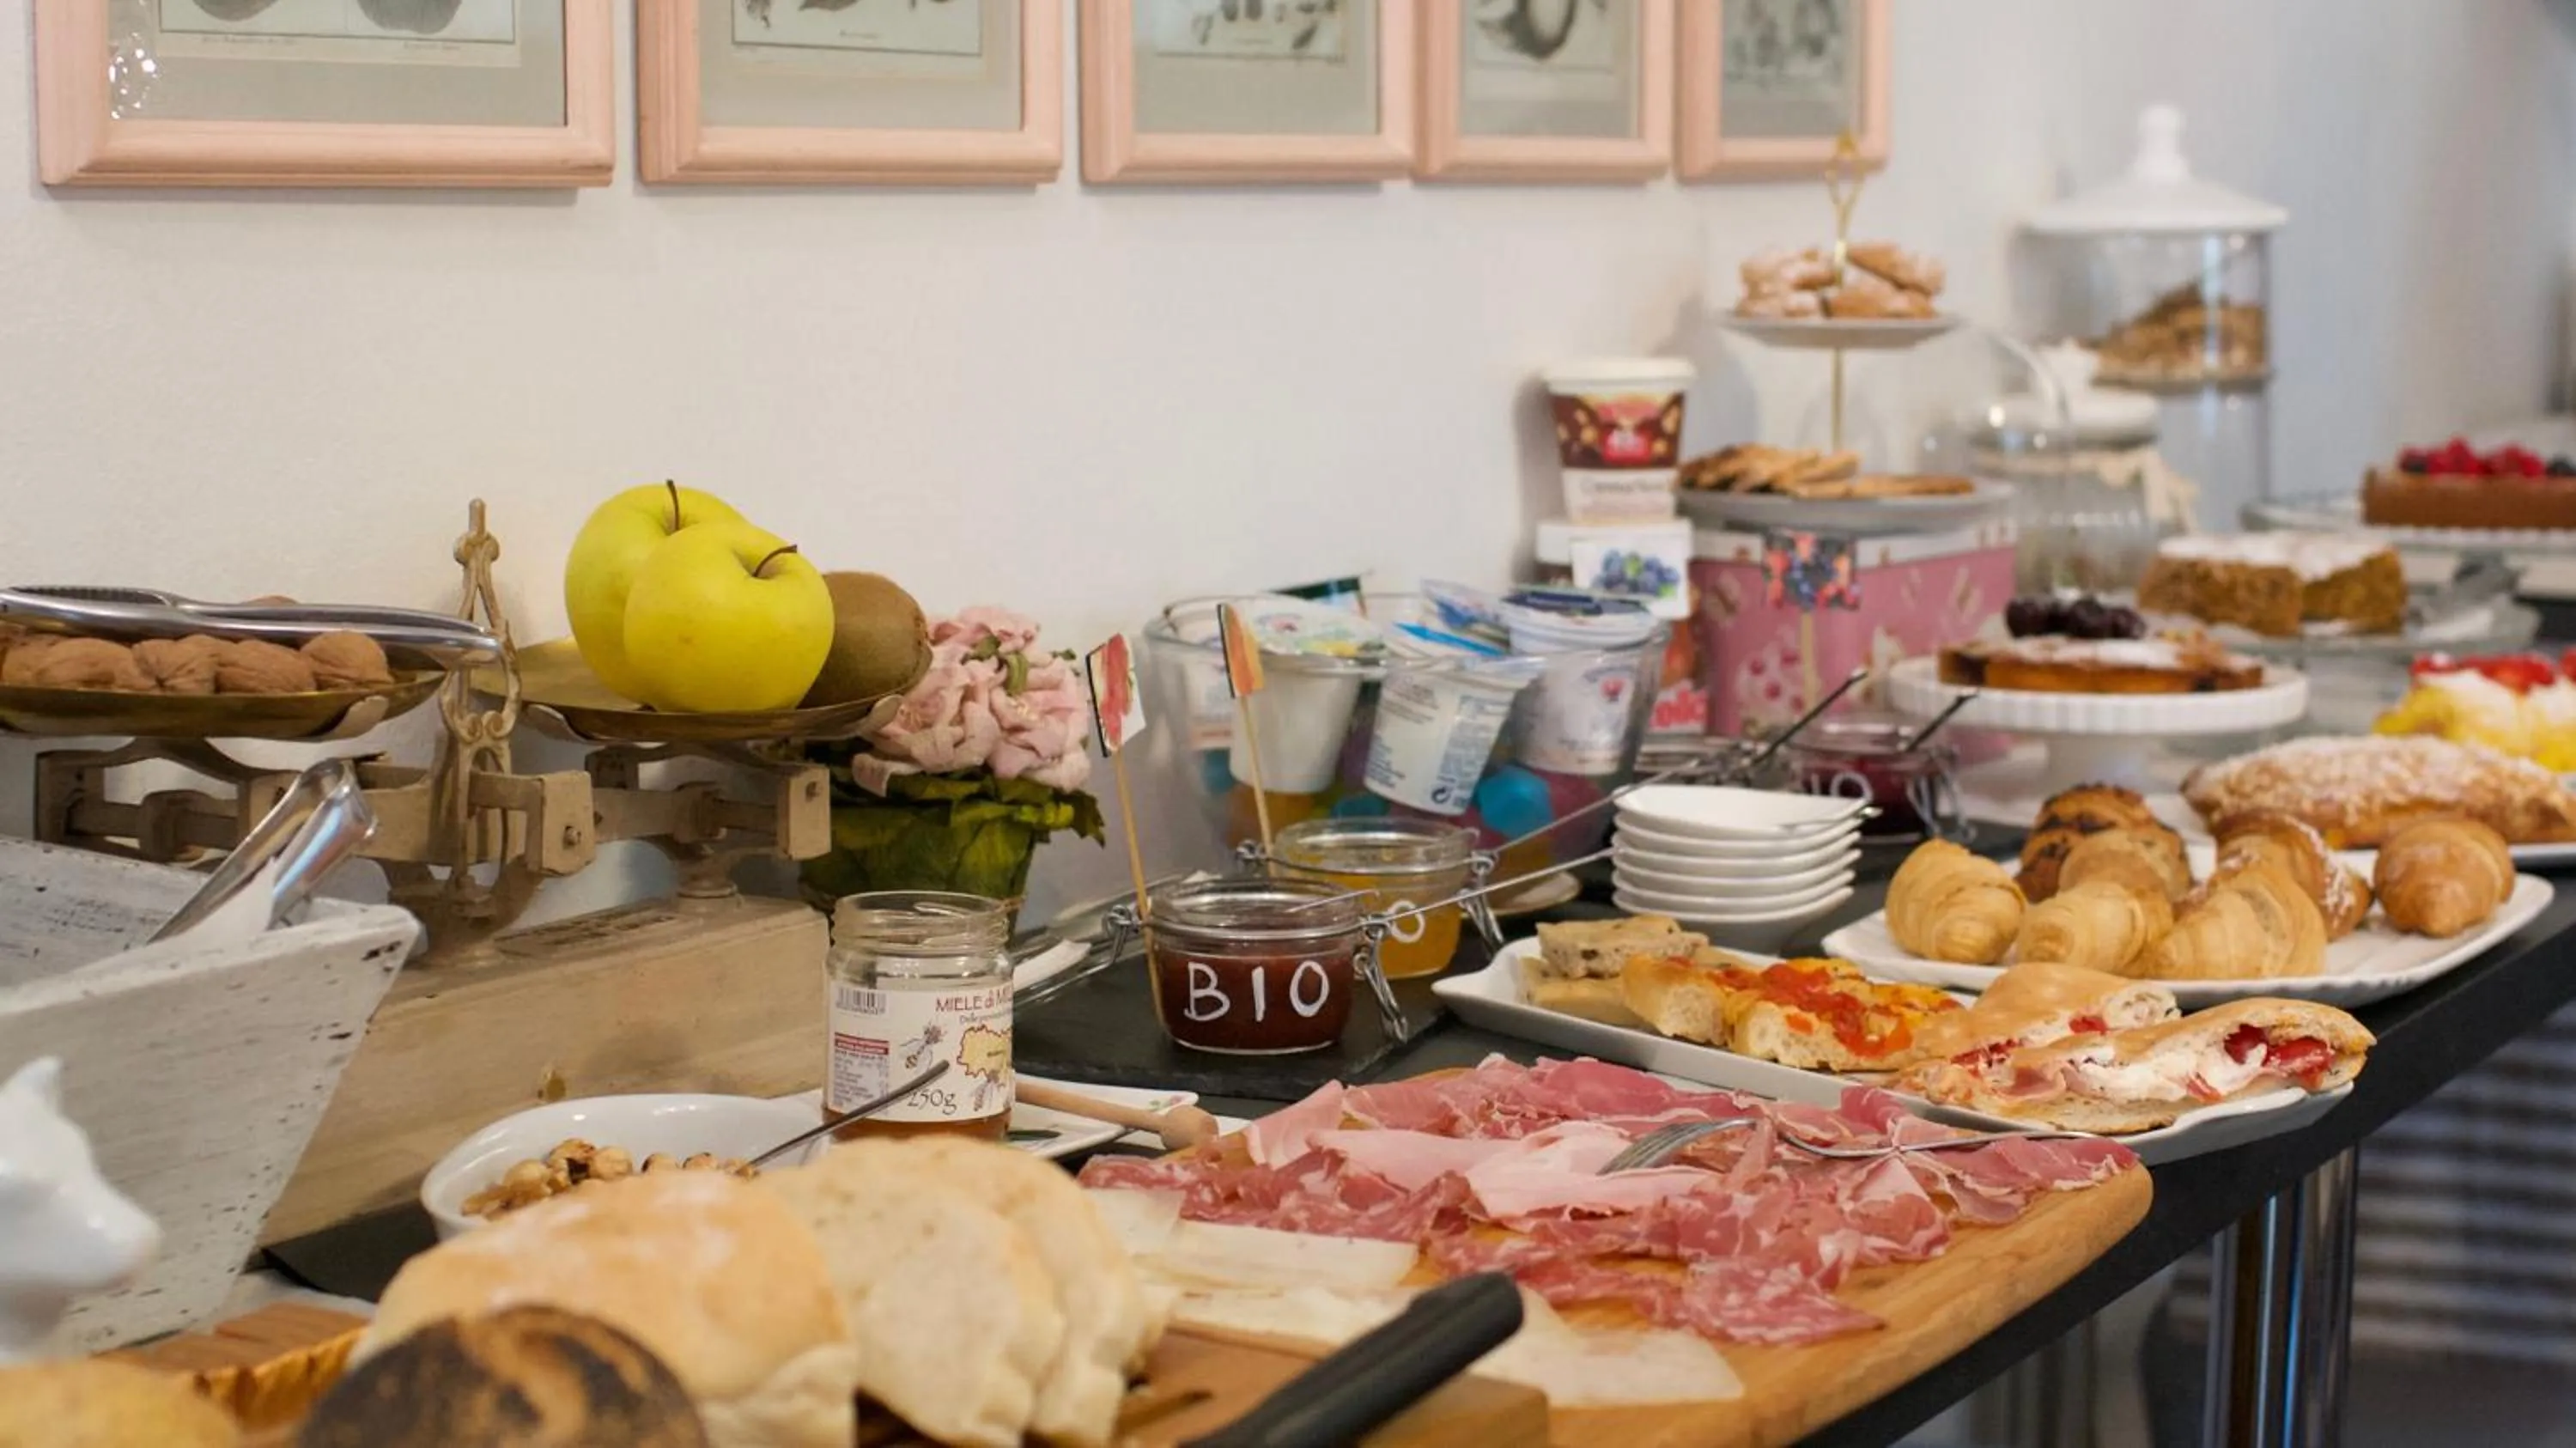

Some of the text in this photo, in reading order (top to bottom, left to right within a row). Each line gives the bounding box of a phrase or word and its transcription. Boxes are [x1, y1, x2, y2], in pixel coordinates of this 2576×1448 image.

[935, 995, 983, 1012] MIELE
[1183, 960, 1330, 1022] BIO
[907, 1088, 957, 1116] 250g
